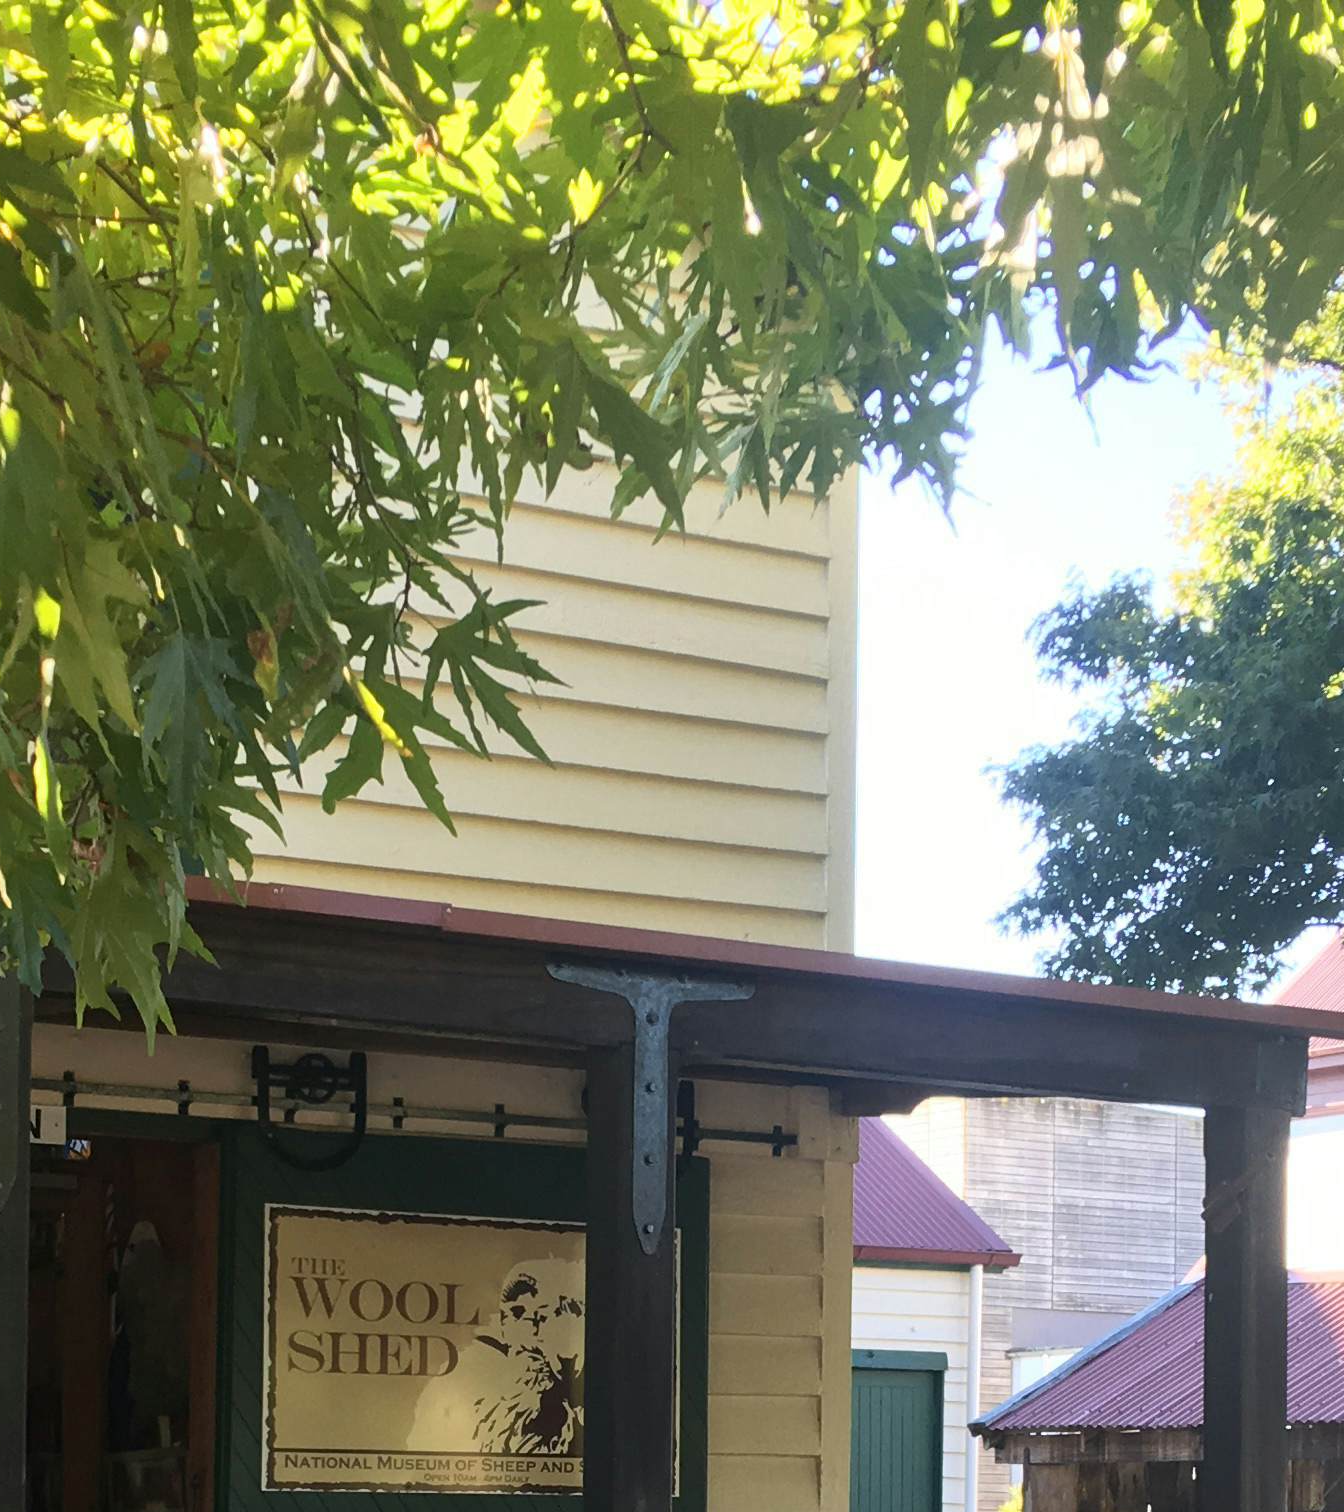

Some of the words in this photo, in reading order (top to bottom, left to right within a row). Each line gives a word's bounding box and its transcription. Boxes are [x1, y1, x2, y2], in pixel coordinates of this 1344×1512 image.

[291, 1257, 346, 1276] THE
[289, 1276, 481, 1326] WOOL
[288, 1330, 459, 1377] SHED
[284, 1454, 373, 1470] NATIONAL
[377, 1456, 451, 1471] MUSEUM
[455, 1459, 477, 1472] OF
[481, 1458, 537, 1473] SHEEP
[540, 1461, 575, 1474] AND
